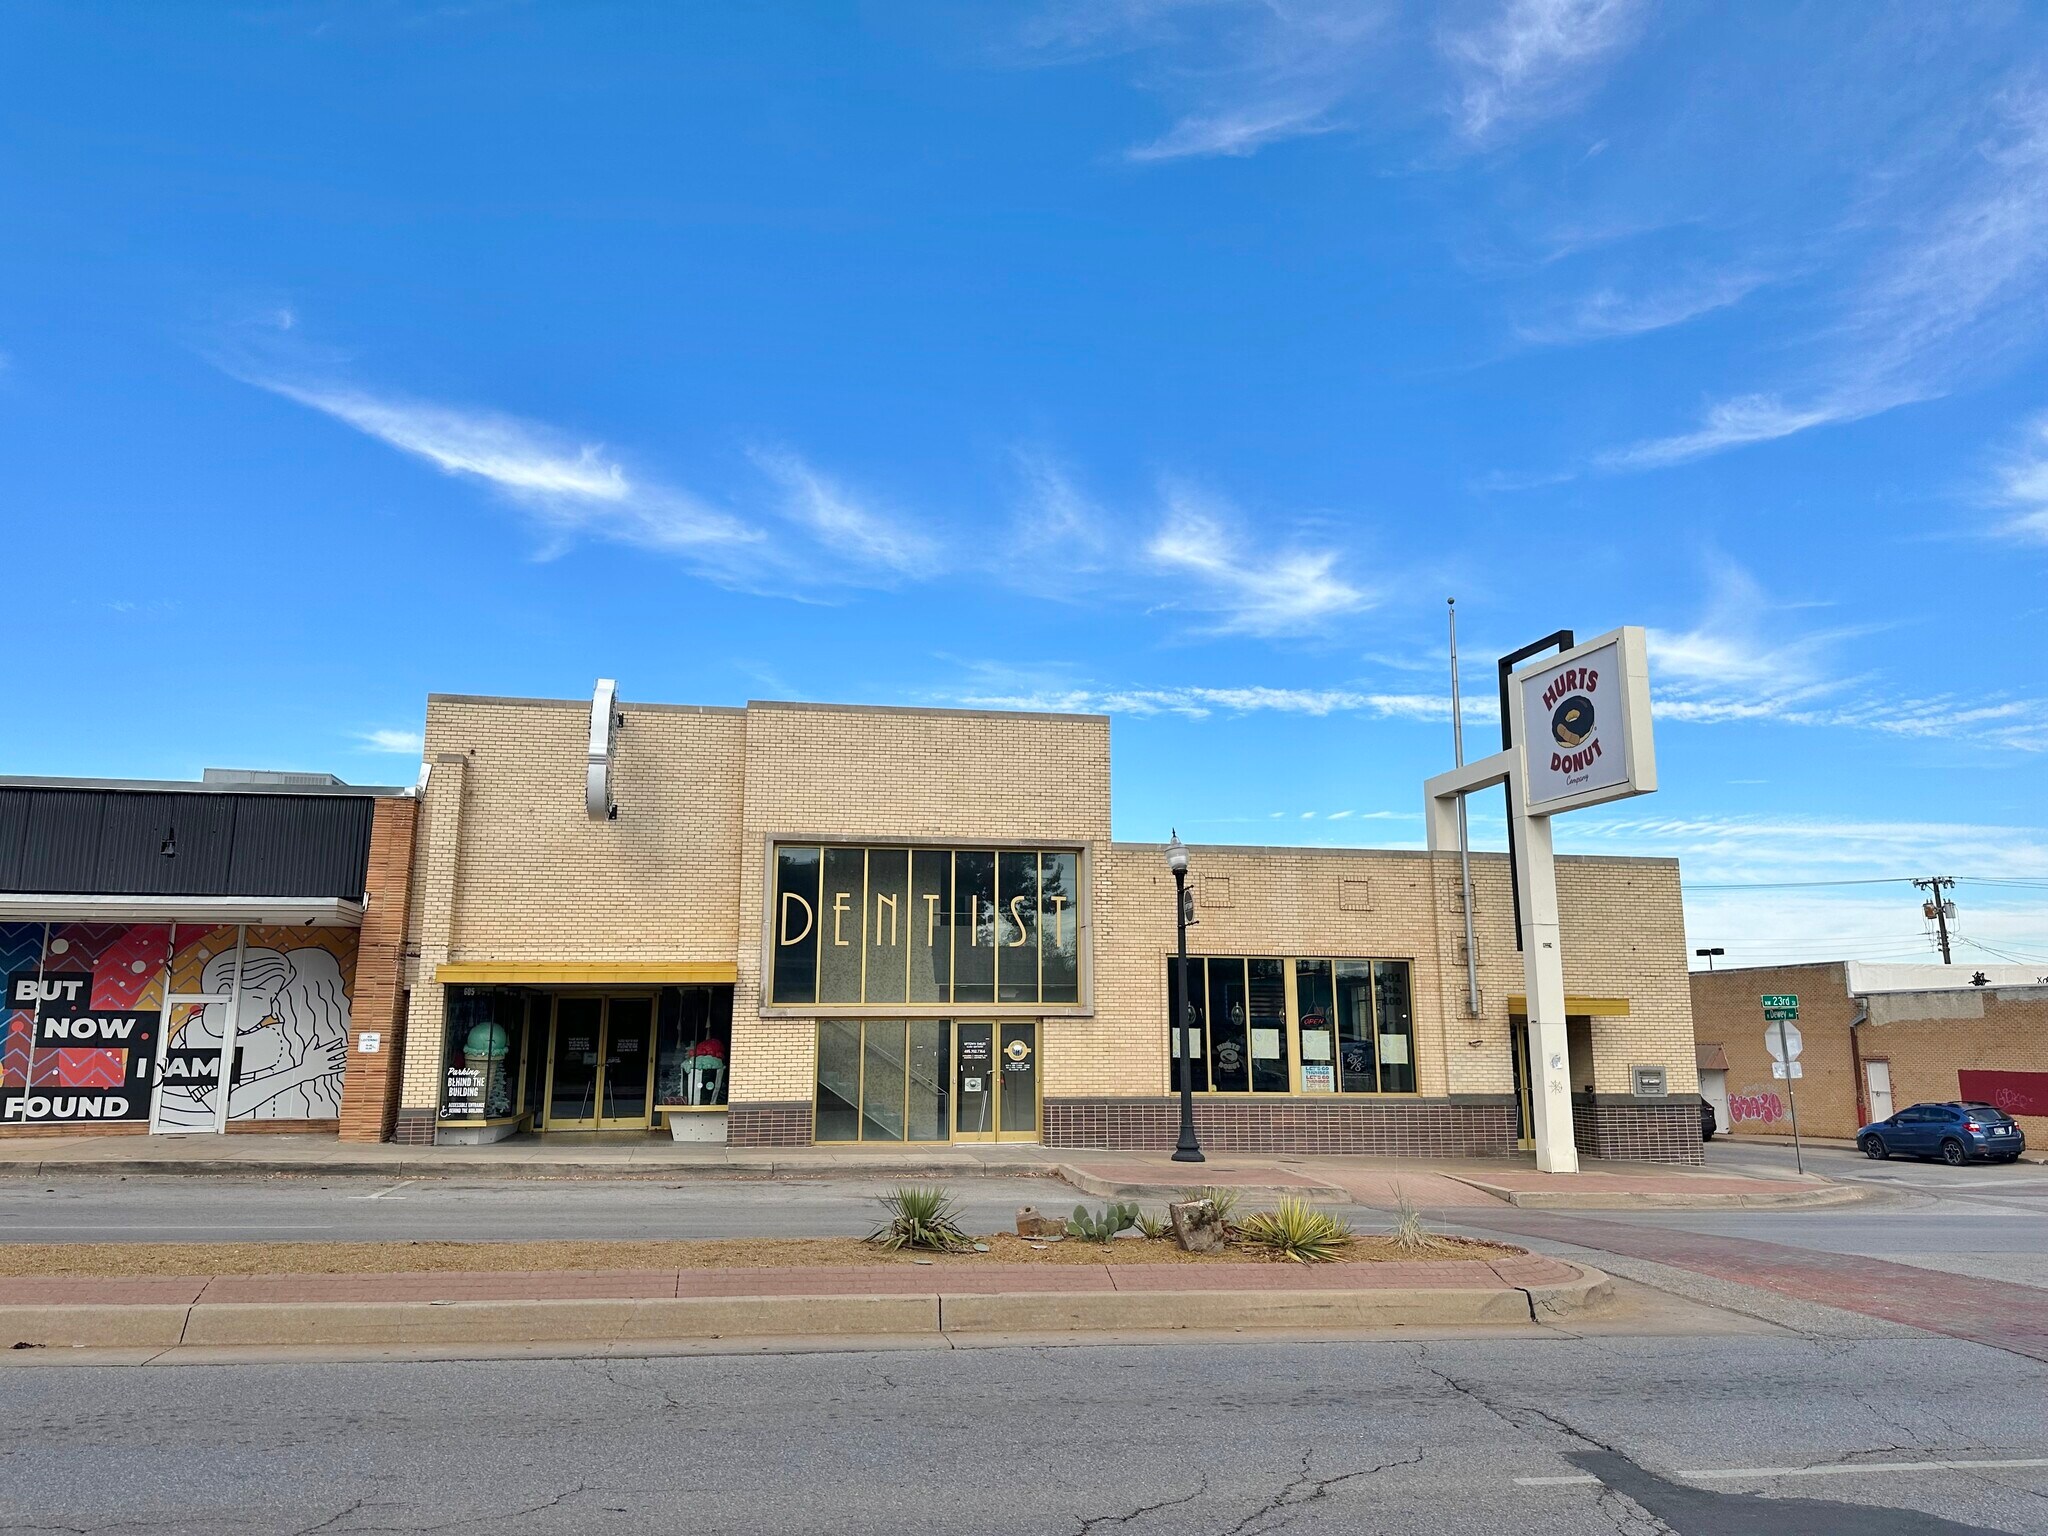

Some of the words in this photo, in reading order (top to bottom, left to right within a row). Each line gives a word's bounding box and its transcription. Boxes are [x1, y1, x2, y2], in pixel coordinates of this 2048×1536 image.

[1542, 667, 1599, 712] HURTS
[1550, 737, 1602, 774] DONUT
[1566, 774, 1589, 786] Company
[780, 892, 1067, 947] DENTIST
[15, 980, 84, 1001] BUT
[1772, 996, 1790, 1006] 23rd
[1770, 1009, 1787, 1020] Dewey
[44, 1017, 137, 1039] NOW
[136, 1057, 148, 1078] I
[168, 1057, 221, 1078] AM
[447, 1067, 480, 1076] Parking
[447, 1078, 472, 1087] BEHIND
[472, 1077, 485, 1087] THE
[448, 1087, 479, 1097] BUILDING
[4, 1096, 130, 1118] FOUND
[662, 1096, 688, 1105] OPEN
